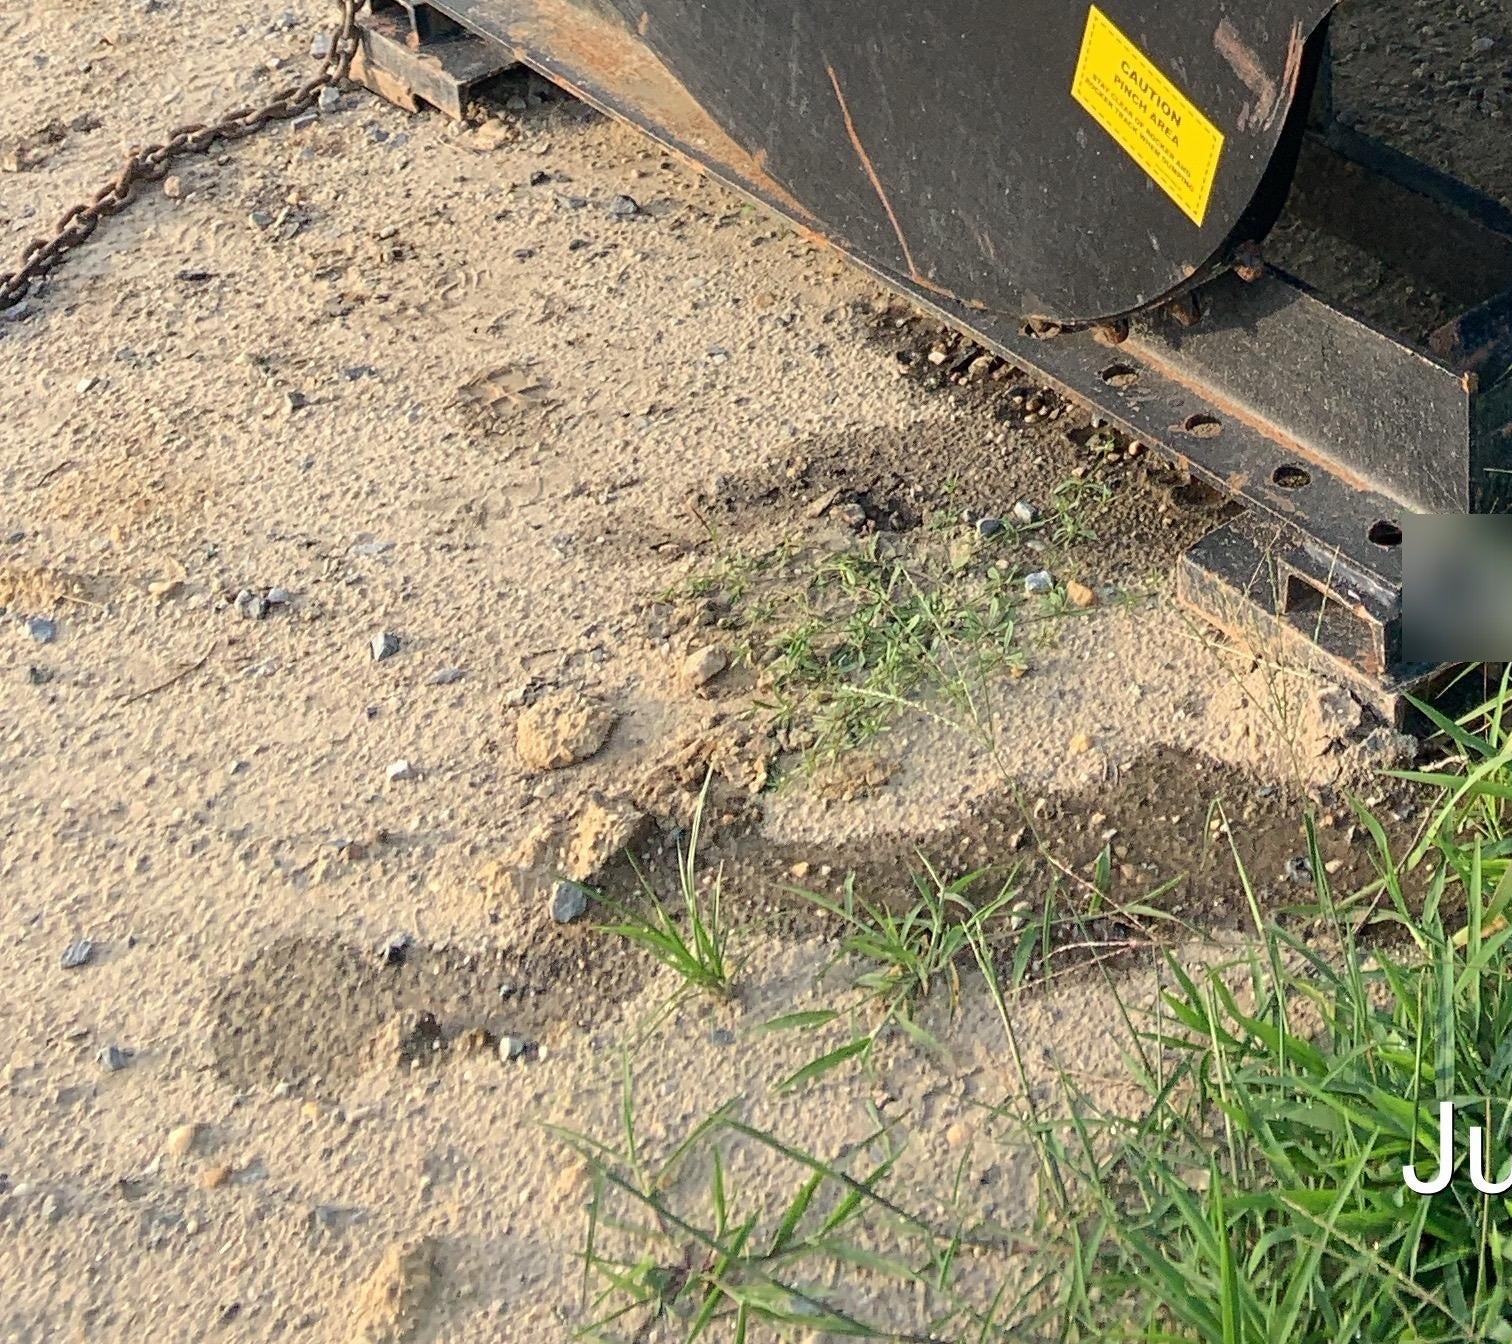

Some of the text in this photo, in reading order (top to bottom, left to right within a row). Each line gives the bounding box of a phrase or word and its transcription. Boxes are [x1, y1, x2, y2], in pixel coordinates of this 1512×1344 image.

[1113, 73, 1148, 114] PINCH
[1149, 112, 1180, 147] AREA
[1121, 60, 1182, 128] CAUTION
